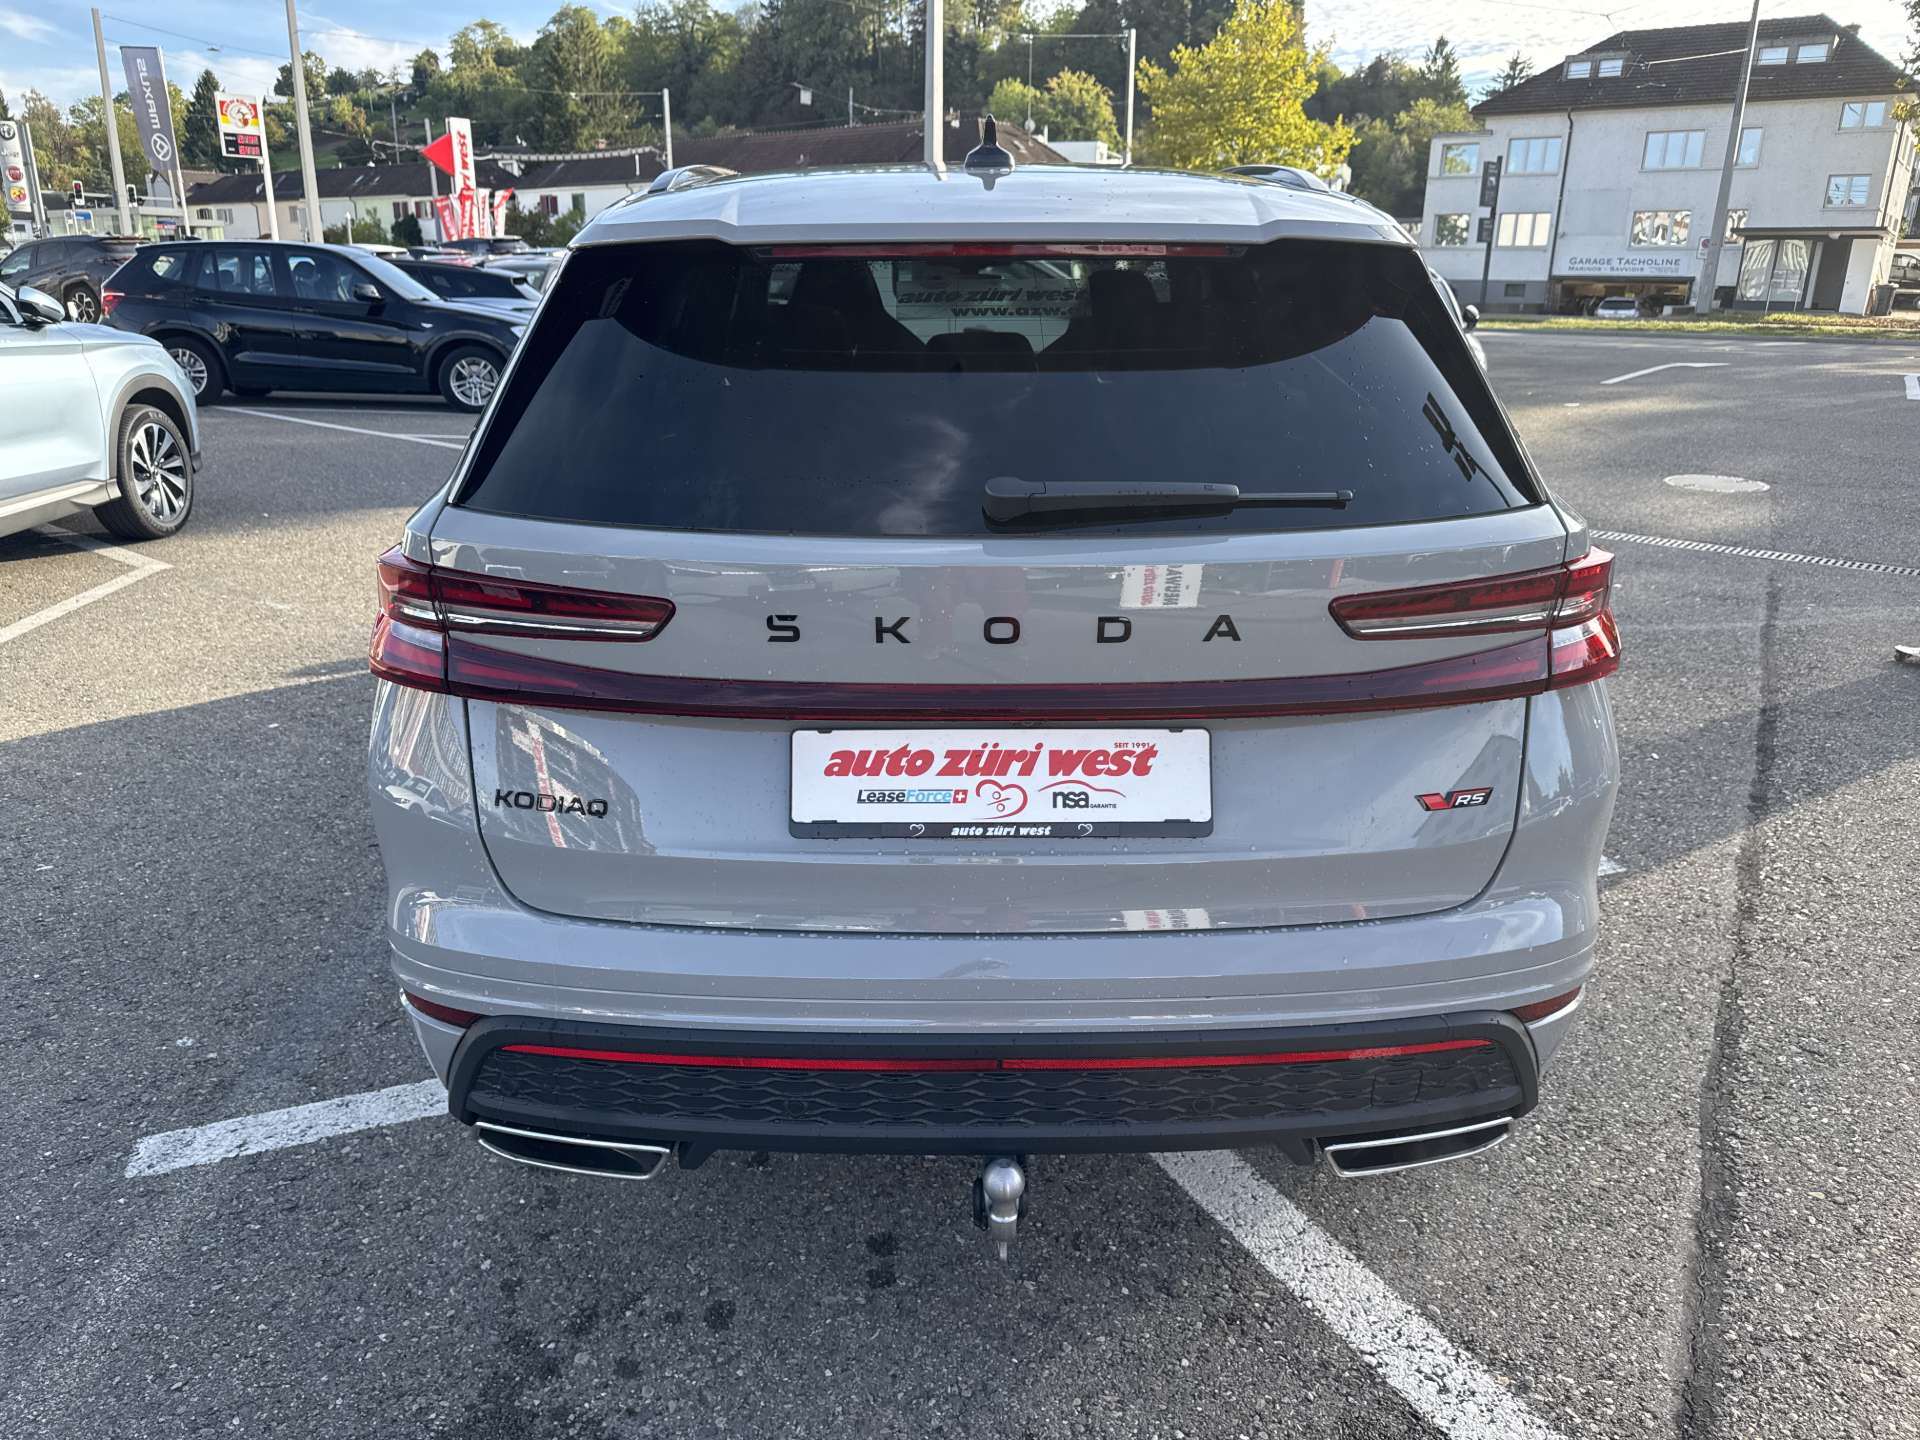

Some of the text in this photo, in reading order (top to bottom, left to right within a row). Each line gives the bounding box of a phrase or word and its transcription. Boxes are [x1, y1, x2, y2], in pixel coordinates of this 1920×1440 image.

[1568, 256, 1681, 266] GARAGE TACHOLINE
[824, 742, 1159, 777] auto züri west
[495, 789, 608, 819] KODIAQ
[857, 789, 952, 803] LeaseForce
[1053, 790, 1090, 809] nsa
[951, 825, 1052, 835] auto züri west
